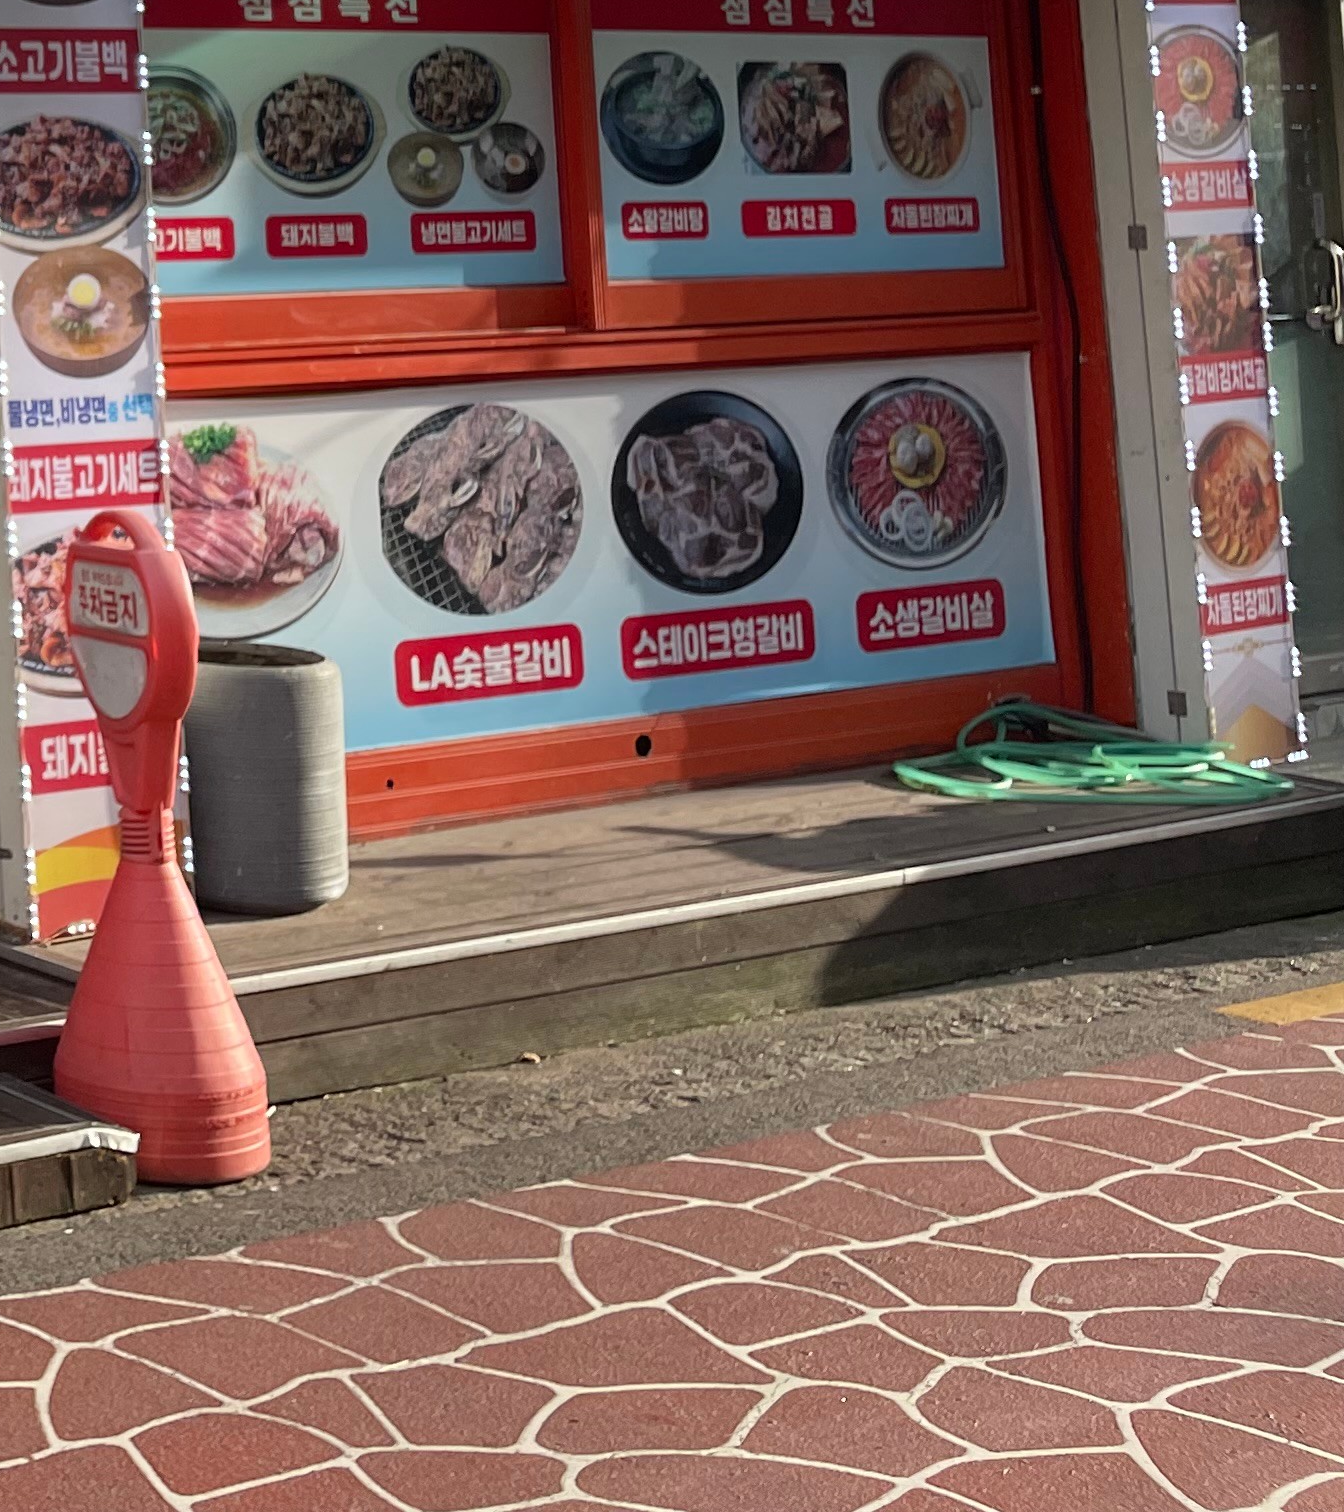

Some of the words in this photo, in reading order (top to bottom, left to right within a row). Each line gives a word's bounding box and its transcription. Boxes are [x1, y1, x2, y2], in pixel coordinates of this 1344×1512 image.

[154, 224, 222, 253] 고기불백
[78, 584, 138, 628] 주차금지
[868, 590, 996, 642] 소생갈비살
[410, 637, 573, 693] LA숯불갈비
[632, 611, 805, 670] 스테이크형갈비
[40, 731, 110, 780] 돼지
